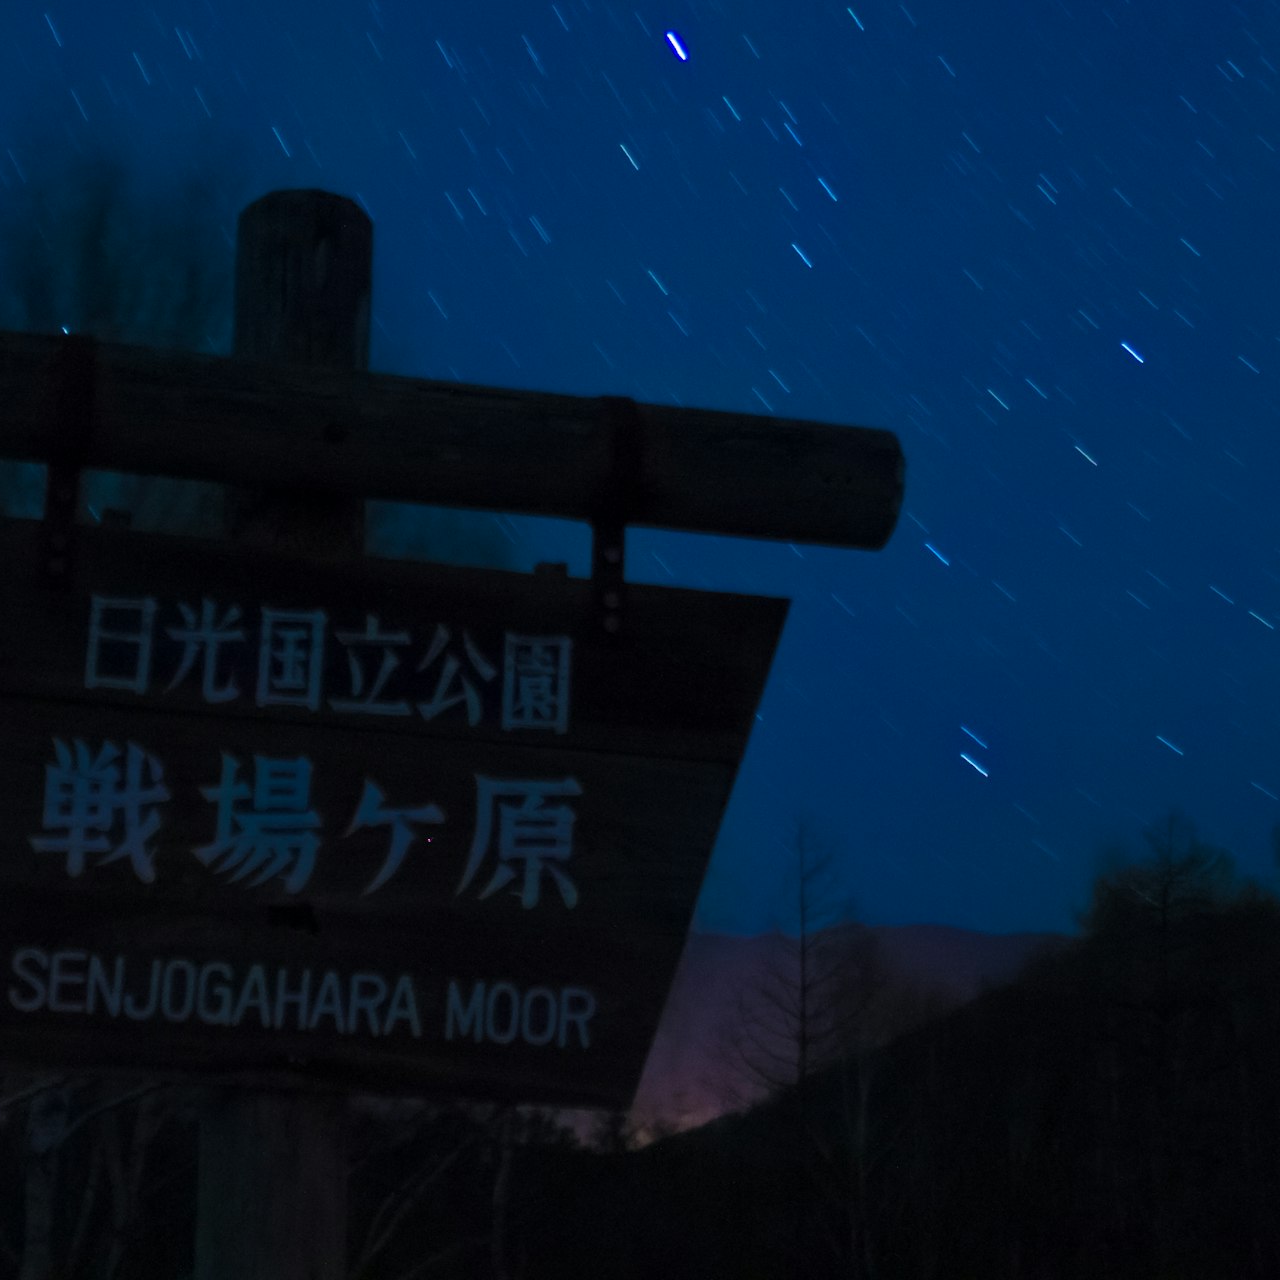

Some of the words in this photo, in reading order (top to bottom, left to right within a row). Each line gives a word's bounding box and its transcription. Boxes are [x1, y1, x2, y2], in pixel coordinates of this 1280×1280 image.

[83, 594, 574, 735] 日光国立公園
[8, 947, 423, 1038] SENJOGAHARA
[445, 980, 596, 1049] MOOR
